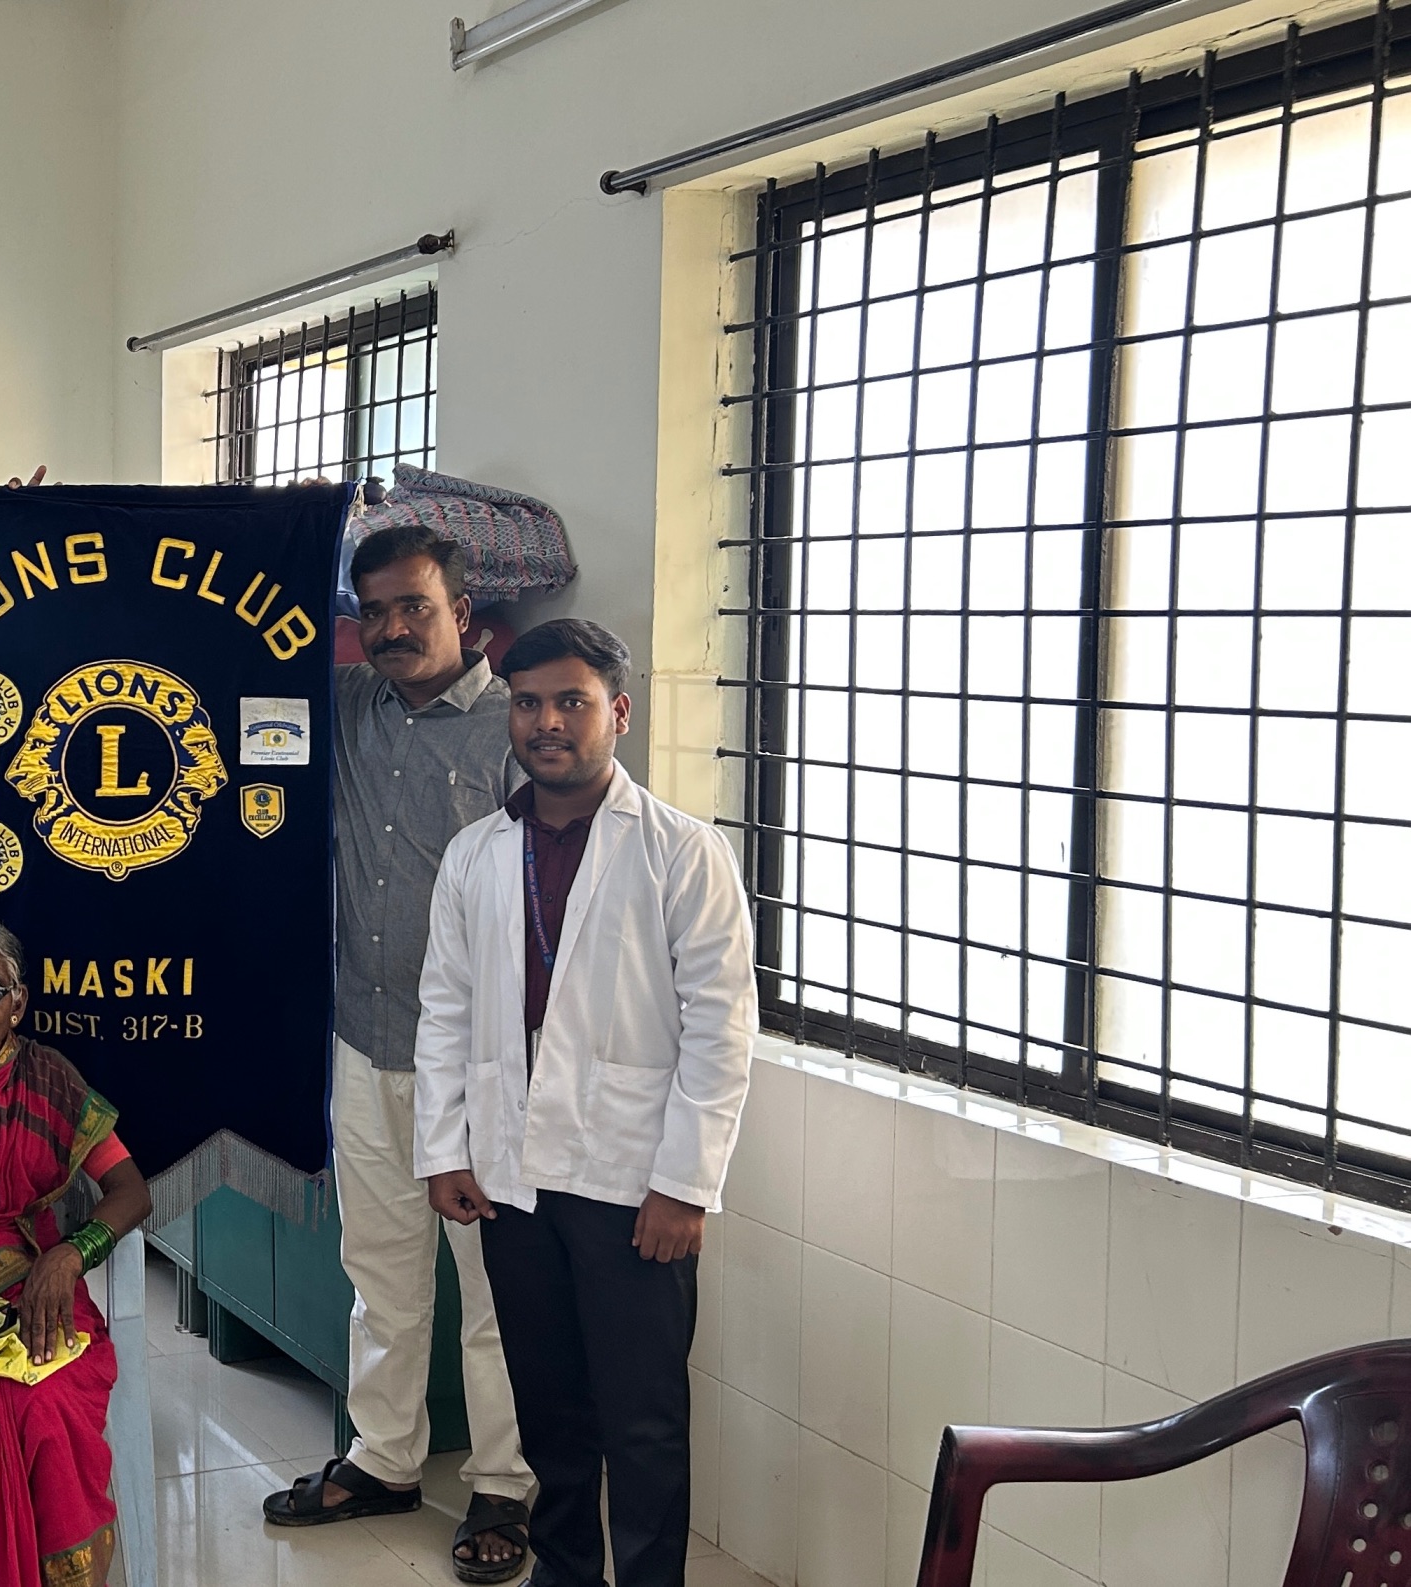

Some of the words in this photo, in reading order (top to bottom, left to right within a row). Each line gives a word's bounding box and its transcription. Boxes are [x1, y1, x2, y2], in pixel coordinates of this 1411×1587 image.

[151, 537, 317, 661] CLUB
[55, 669, 186, 718] LIONS
[95, 725, 151, 797] L
[59, 821, 176, 857] INTERNATIONAL
[43, 957, 194, 998] MASKI
[34, 1010, 104, 1041] DIST.
[122, 1013, 204, 1041] 317-B
